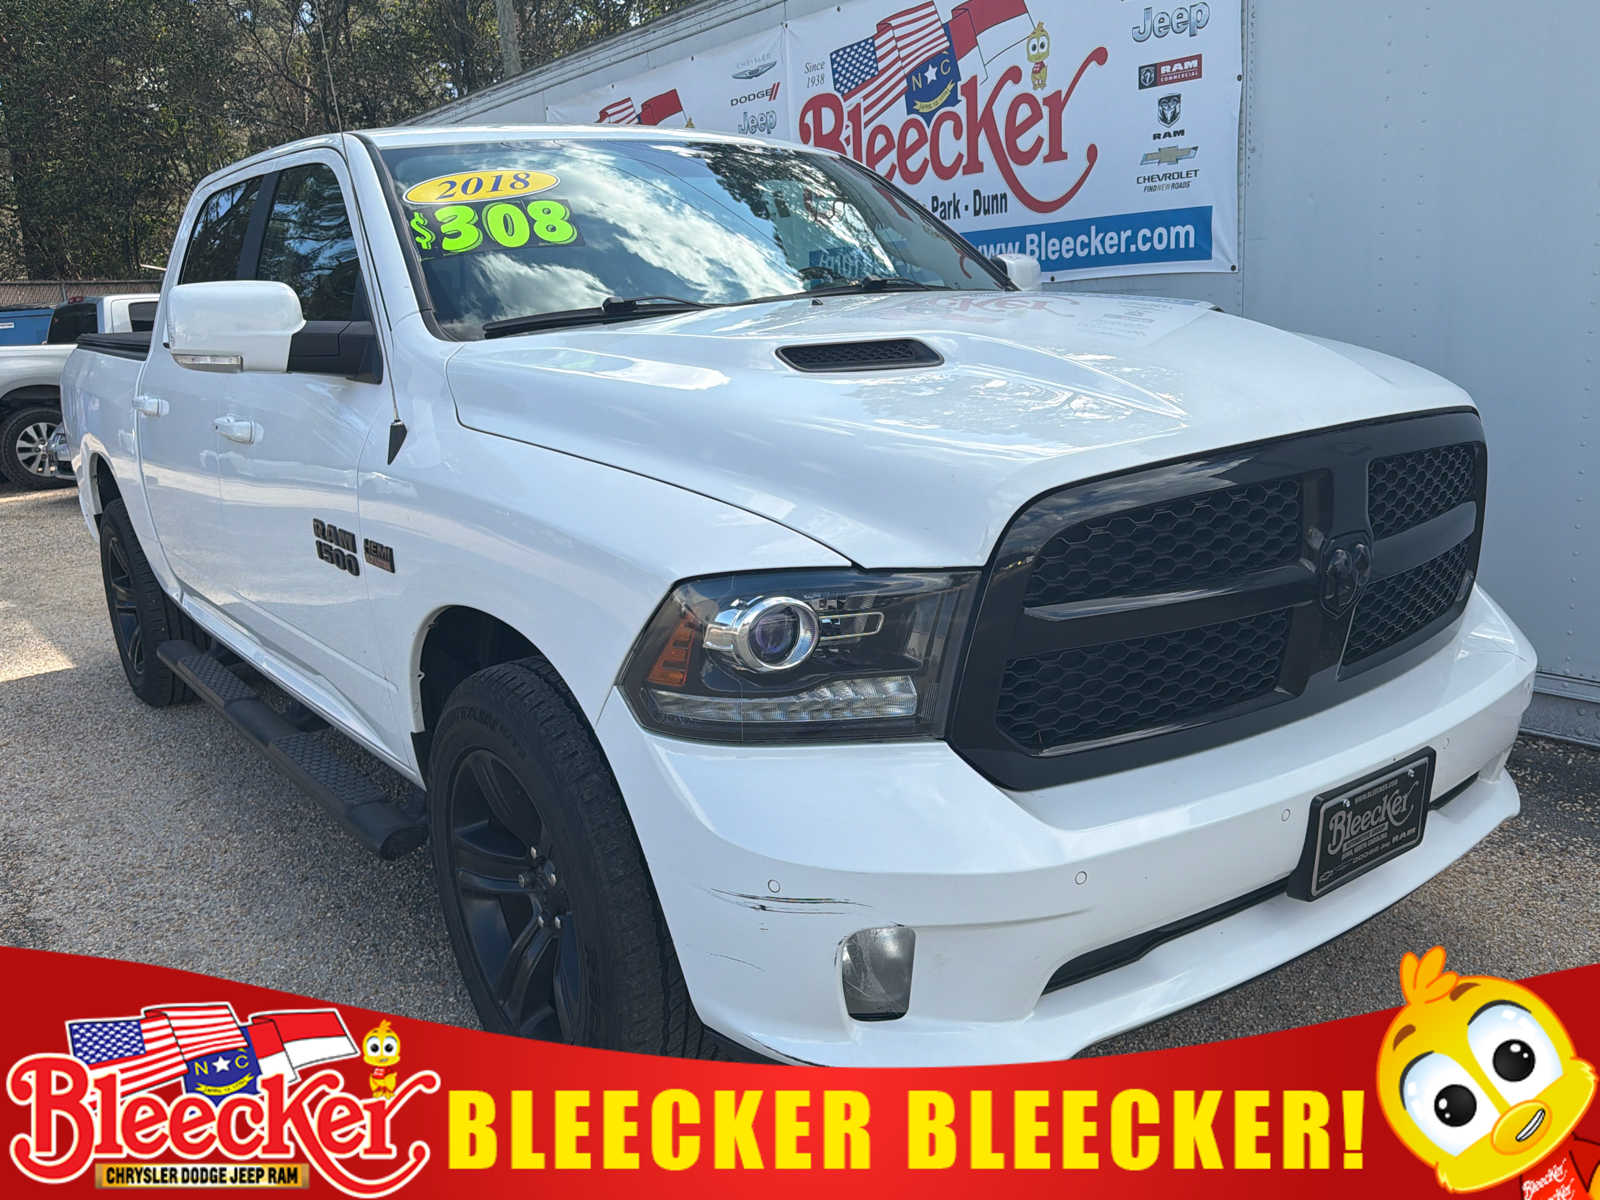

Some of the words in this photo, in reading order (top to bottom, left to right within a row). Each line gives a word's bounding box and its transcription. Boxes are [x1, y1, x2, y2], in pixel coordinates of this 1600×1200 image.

[1132, 2, 1210, 42] Jeep
[803, 61, 825, 74] Since
[1160, 60, 1199, 74] RAM
[806, 73, 825, 88] 1938
[730, 88, 772, 107] DODGE
[737, 110, 777, 135] Jeep
[1152, 129, 1185, 141] RAM
[435, 172, 531, 200] 2018
[1136, 169, 1200, 184] CHEVROLET
[931, 194, 962, 220] Park
[973, 189, 1008, 216] Dunn
[410, 201, 578, 252] $308
[978, 224, 1195, 261] wwwBleecker.com
[312, 518, 357, 554] RAM
[315, 540, 360, 576] 1500
[363, 538, 394, 564] HEMI
